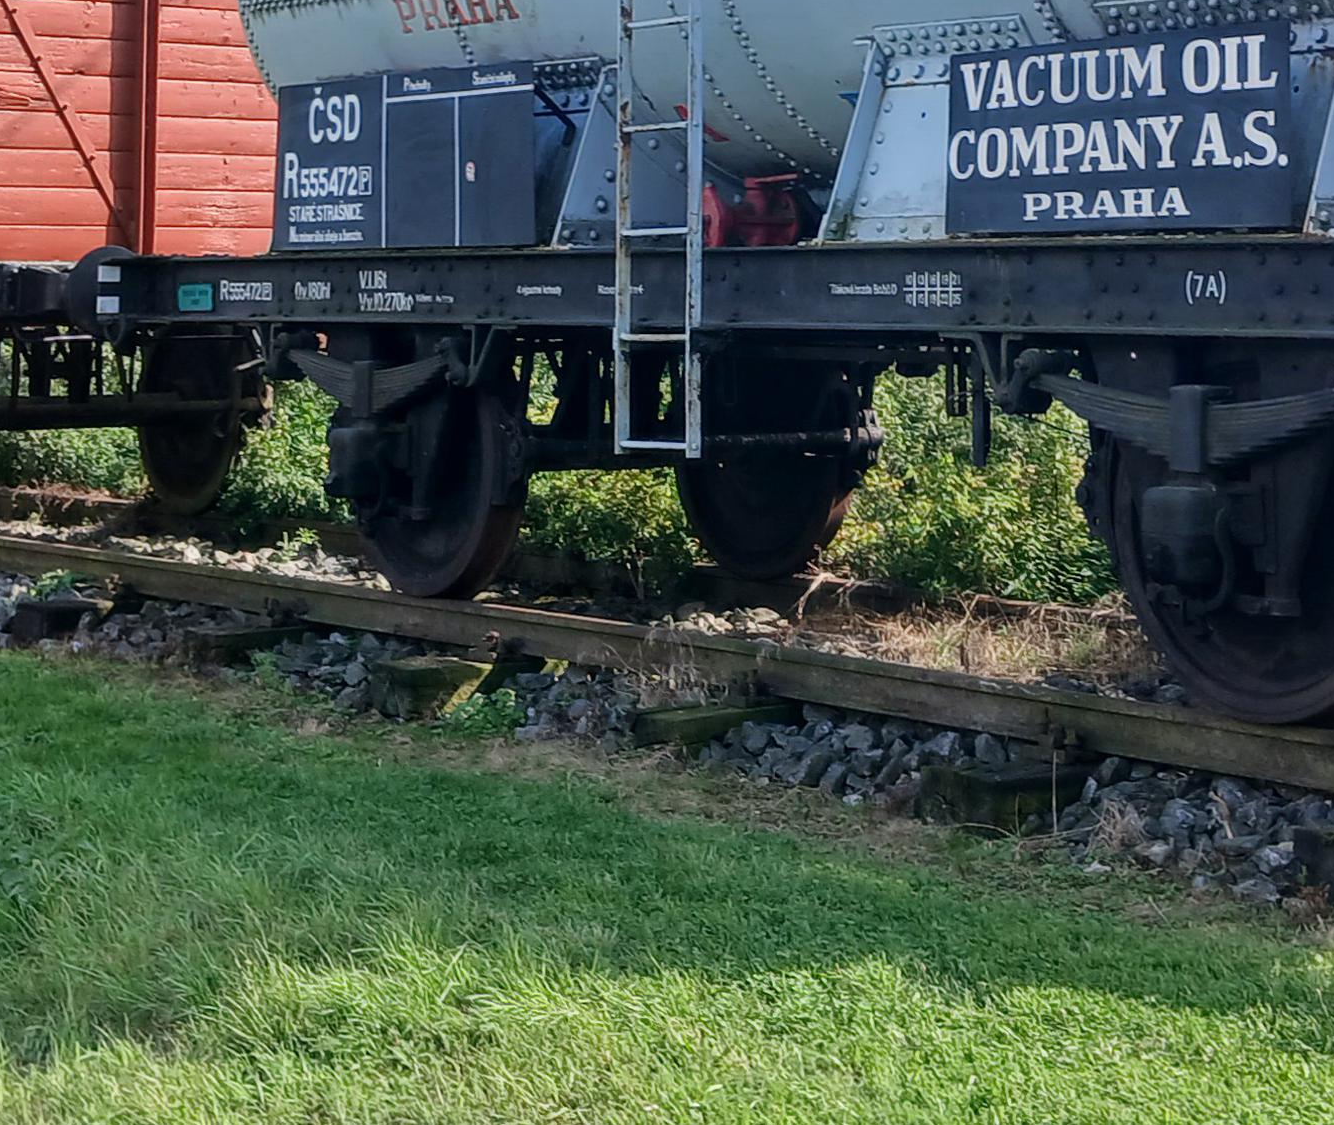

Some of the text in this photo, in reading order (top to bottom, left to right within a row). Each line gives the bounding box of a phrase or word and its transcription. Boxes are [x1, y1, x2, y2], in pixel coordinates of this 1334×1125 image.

[960, 34, 1279, 112] VACUUM OIL
[308, 87, 361, 144] ČSD
[949, 111, 1288, 179] COMPANY A.S.
[1023, 187, 1190, 221] PRAHA
[1185, 270, 1227, 305] (7A)
